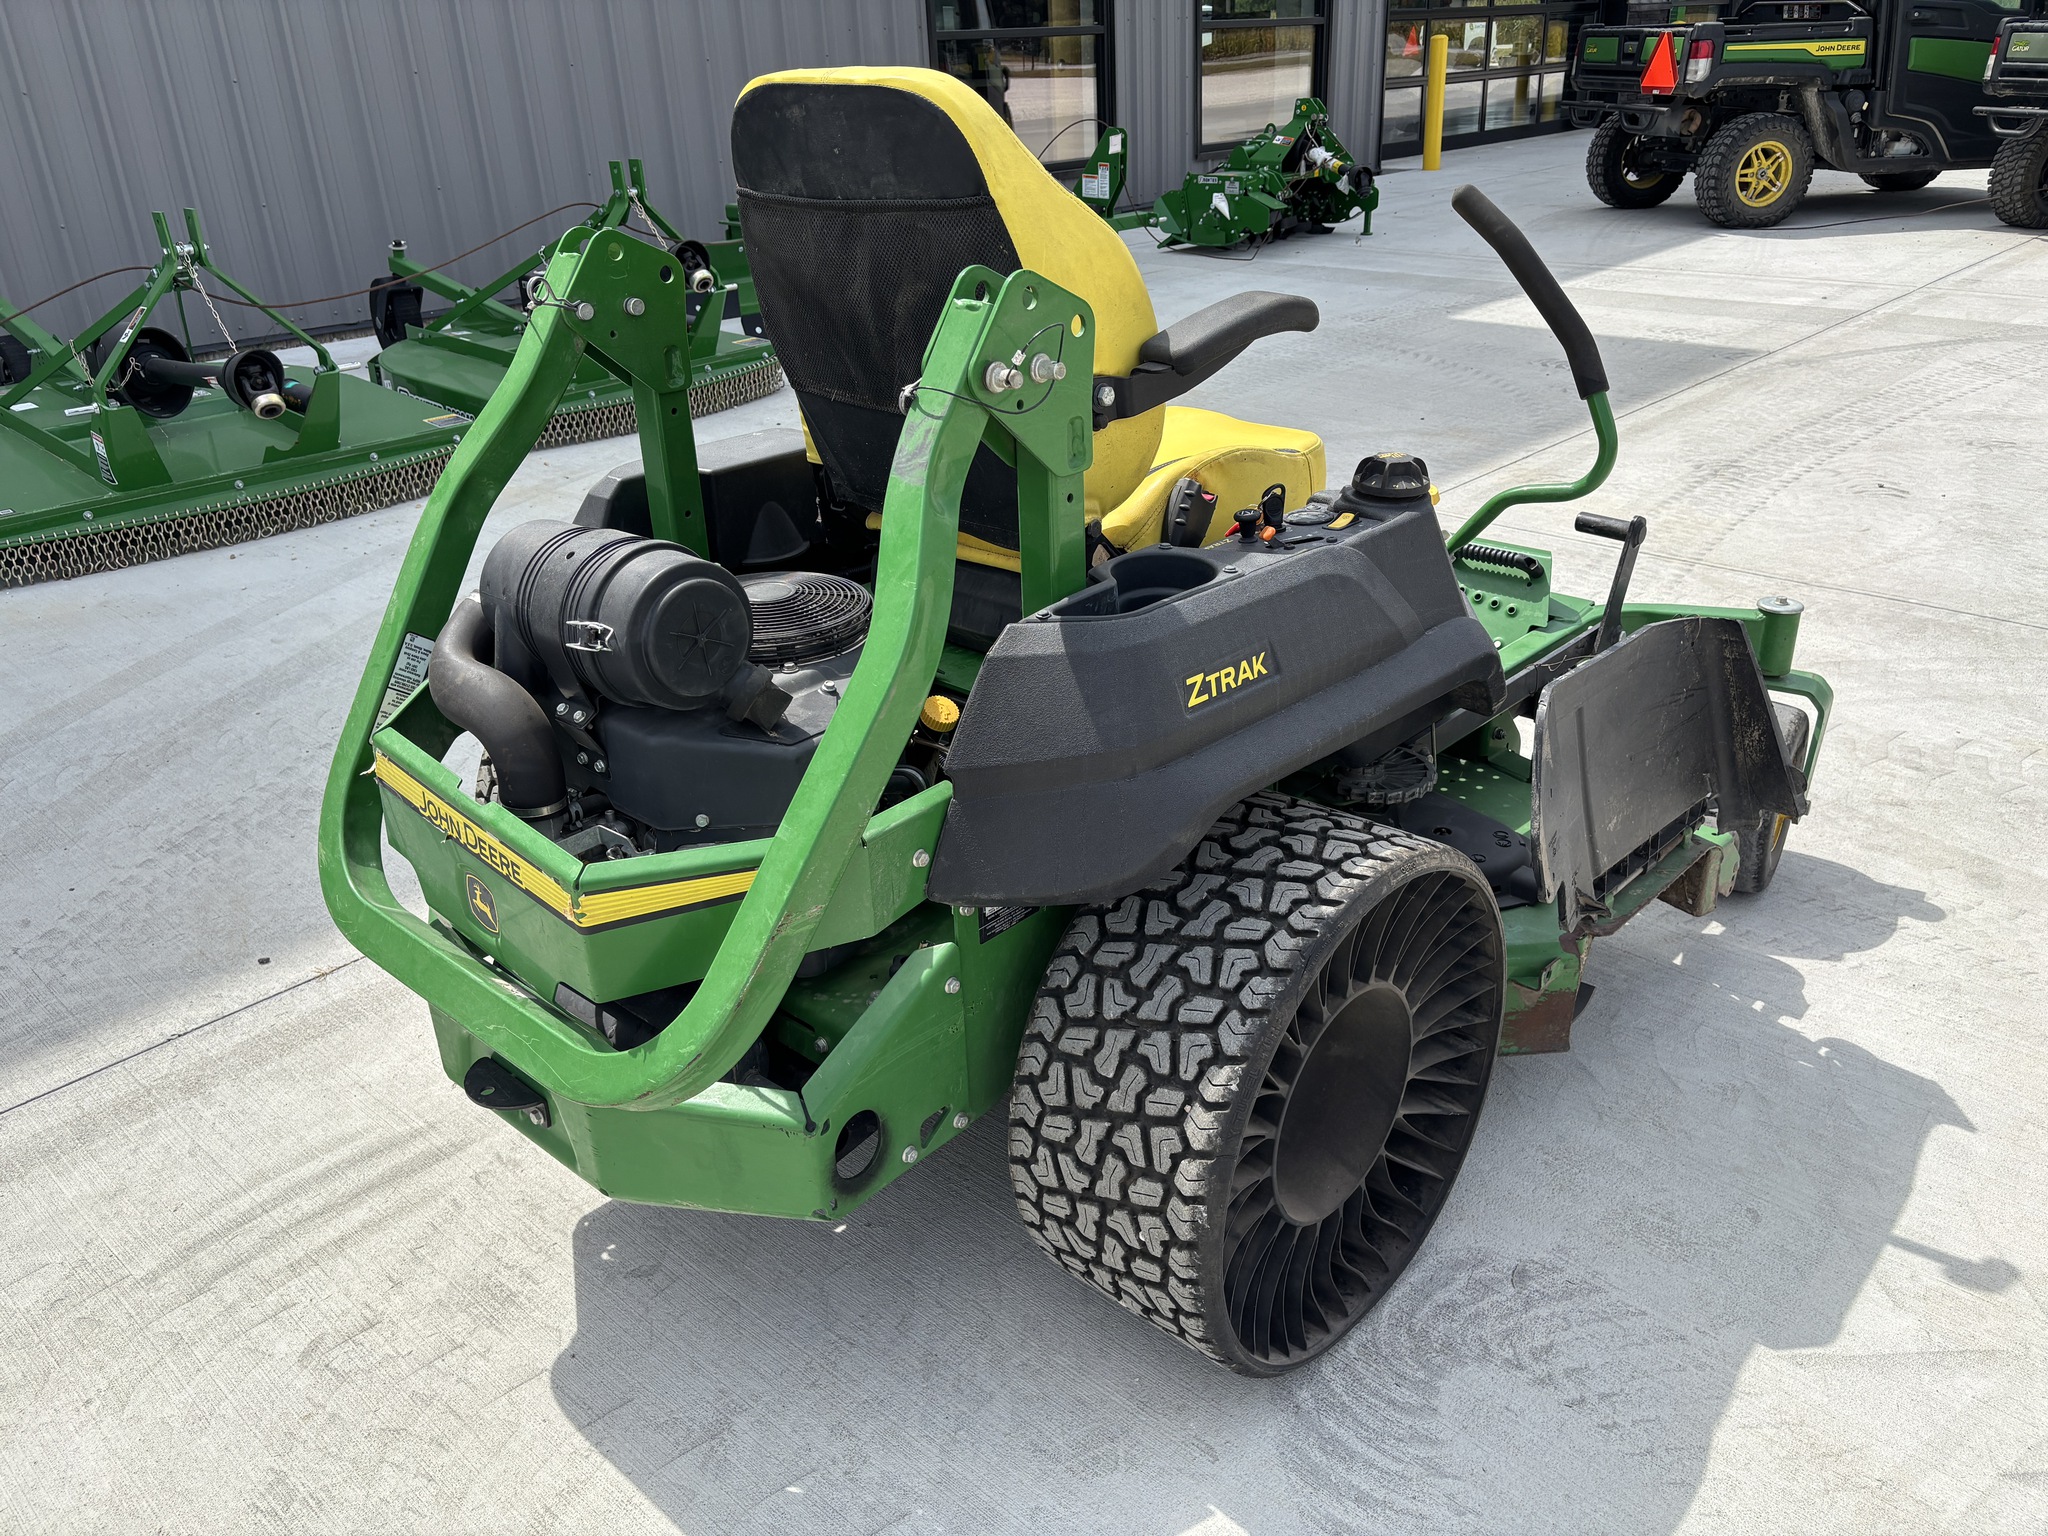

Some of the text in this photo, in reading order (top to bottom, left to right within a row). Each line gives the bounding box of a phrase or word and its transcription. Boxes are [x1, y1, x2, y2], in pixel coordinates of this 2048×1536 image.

[1186, 651, 1268, 708] ZTRAK
[419, 791, 523, 886] JOHN DEERE
